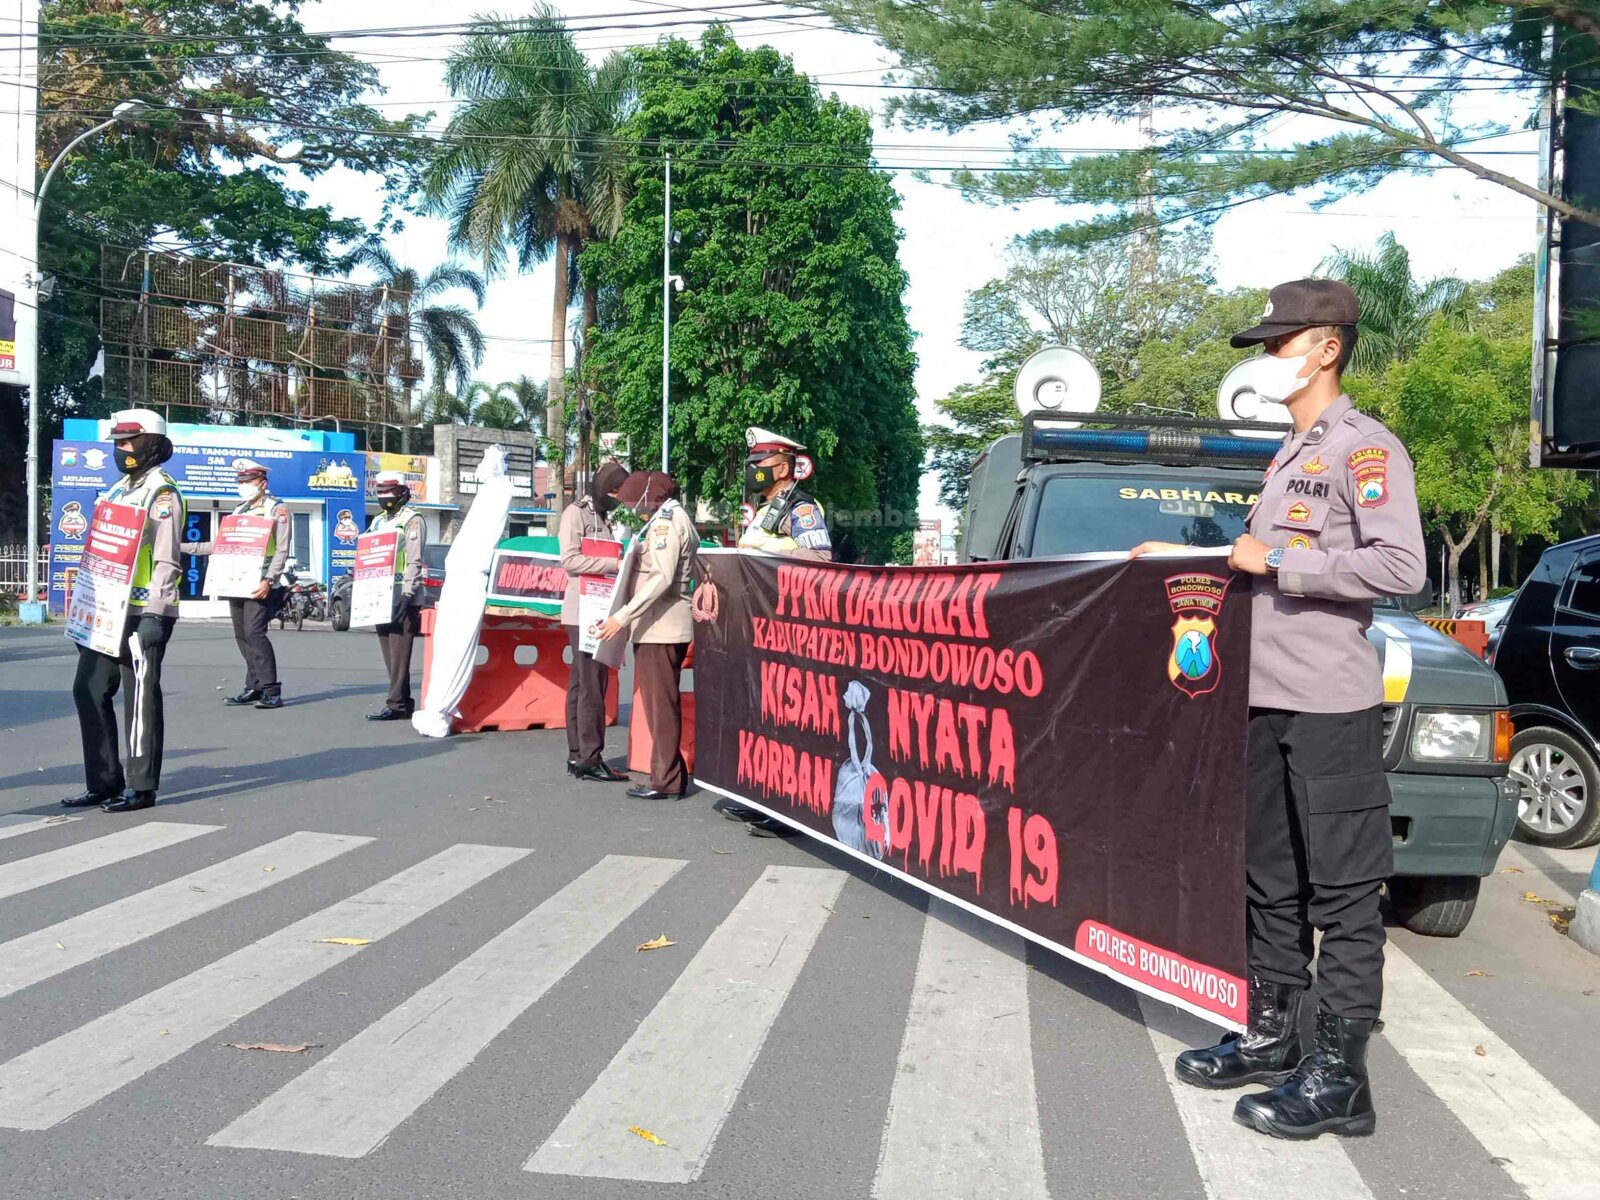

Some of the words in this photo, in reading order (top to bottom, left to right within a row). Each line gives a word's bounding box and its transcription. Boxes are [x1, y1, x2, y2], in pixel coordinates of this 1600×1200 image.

[173, 447, 199, 455] NTAS
[254, 450, 293, 459] SEMERU
[207, 457, 226, 465] 5M
[1119, 487, 1259, 505] SABHARA
[1286, 479, 1330, 497] POLRI
[187, 515, 201, 595] POISI
[1170, 584, 1222, 595] BONDOWOSO
[1181, 576, 1211, 585] POLRES
[776, 565, 842, 623] PPKM
[848, 570, 1003, 639] DARURAT
[1176, 598, 1195, 608] JAWA
[1196, 599, 1214, 609] TIMUR
[753, 617, 857, 667] KABUPATEN
[860, 633, 1044, 698] BONDOWOSO
[761, 661, 841, 742] KISAH
[887, 688, 1016, 795] NYATA
[737, 729, 833, 817] KORBAN
[862, 771, 987, 896] COVID
[1007, 806, 1058, 910] 19
[1088, 926, 1136, 967] POLRES
[1139, 947, 1238, 1009] BONDOWOSO
